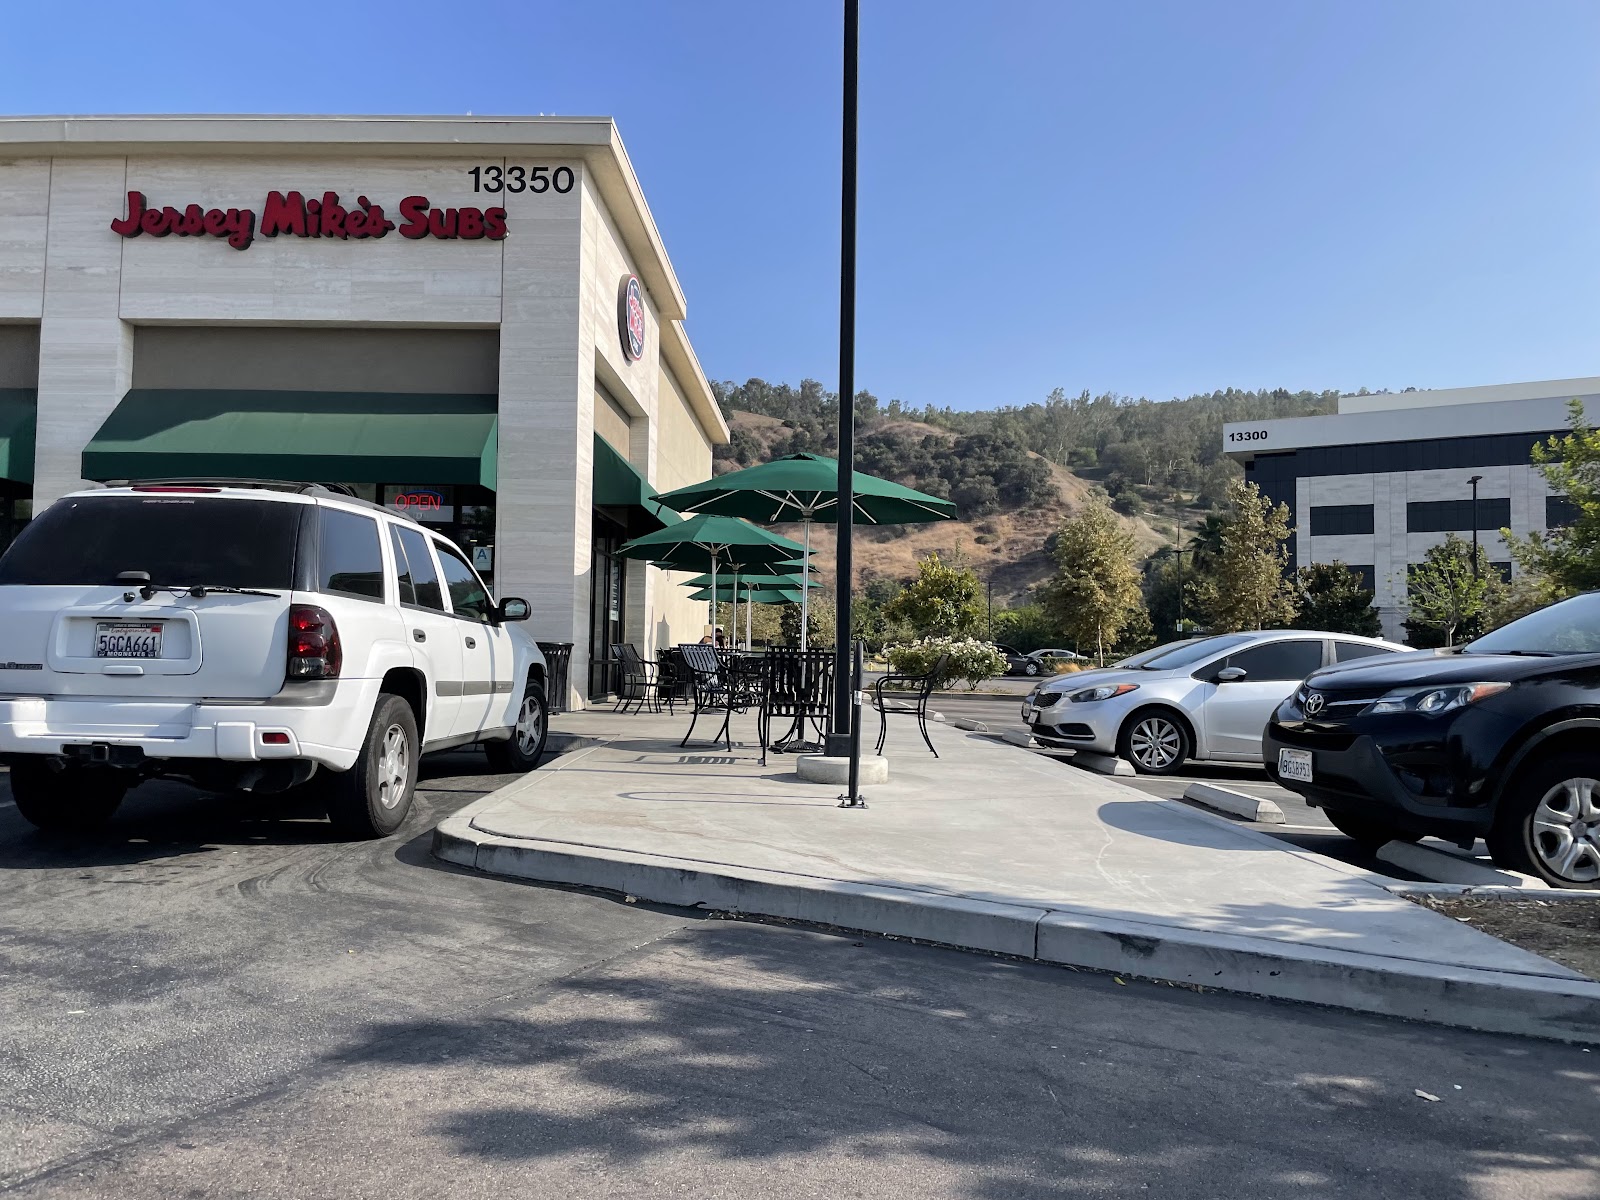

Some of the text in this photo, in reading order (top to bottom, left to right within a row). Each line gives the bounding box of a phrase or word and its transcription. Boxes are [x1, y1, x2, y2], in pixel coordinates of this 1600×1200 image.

[468, 166, 575, 194] 13350
[111, 190, 255, 250] Jersey
[260, 190, 395, 240] Mike's
[1229, 430, 1268, 442] 13300
[395, 494, 441, 511] OPEN
[476, 548, 487, 560] A
[110, 627, 148, 636] California
[99, 635, 157, 652] 5GCA661
